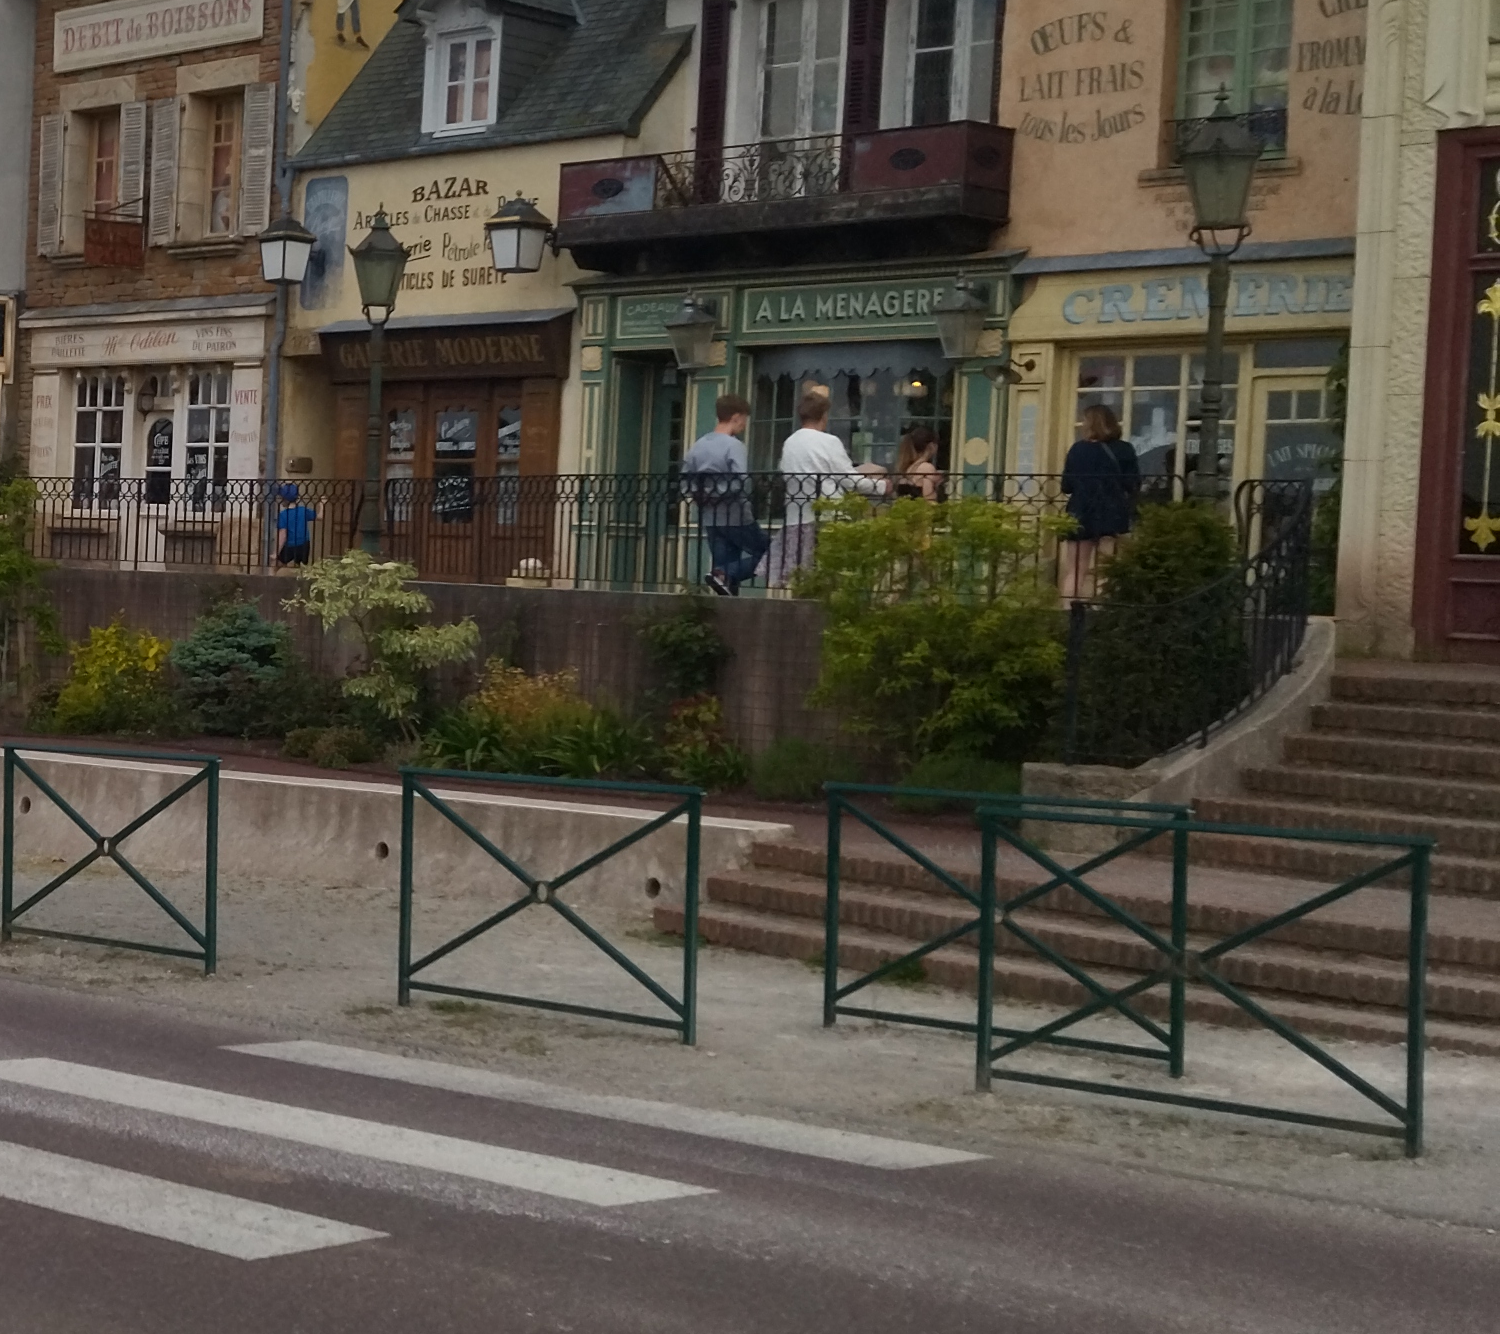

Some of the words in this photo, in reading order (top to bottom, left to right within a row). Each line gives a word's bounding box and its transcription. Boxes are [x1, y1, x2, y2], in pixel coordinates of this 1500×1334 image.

[126, 18, 142, 42] de
[1113, 18, 1134, 45] &
[1296, 35, 1366, 73] FROMA
[1018, 70, 1070, 103] LAIT
[1075, 60, 1146, 96] FRAIS
[1321, 82, 1343, 115] la
[1058, 111, 1086, 144] les
[412, 177, 490, 203] BAZAR
[353, 210, 409, 231] ARLES
[424, 204, 471, 223] CHASSE
[442, 269, 455, 289] DE
[755, 296, 773, 323] A
[780, 294, 806, 322] LA
[129, 331, 179, 353] Odilon
[195, 327, 214, 339] VINS
[216, 326, 233, 338] FINS
[192, 341, 202, 352] DU
[206, 341, 237, 352] PATRON
[434, 333, 546, 367] MODERNE
[36, 395, 52, 409] PRIX
[234, 389, 258, 405] VENTE
